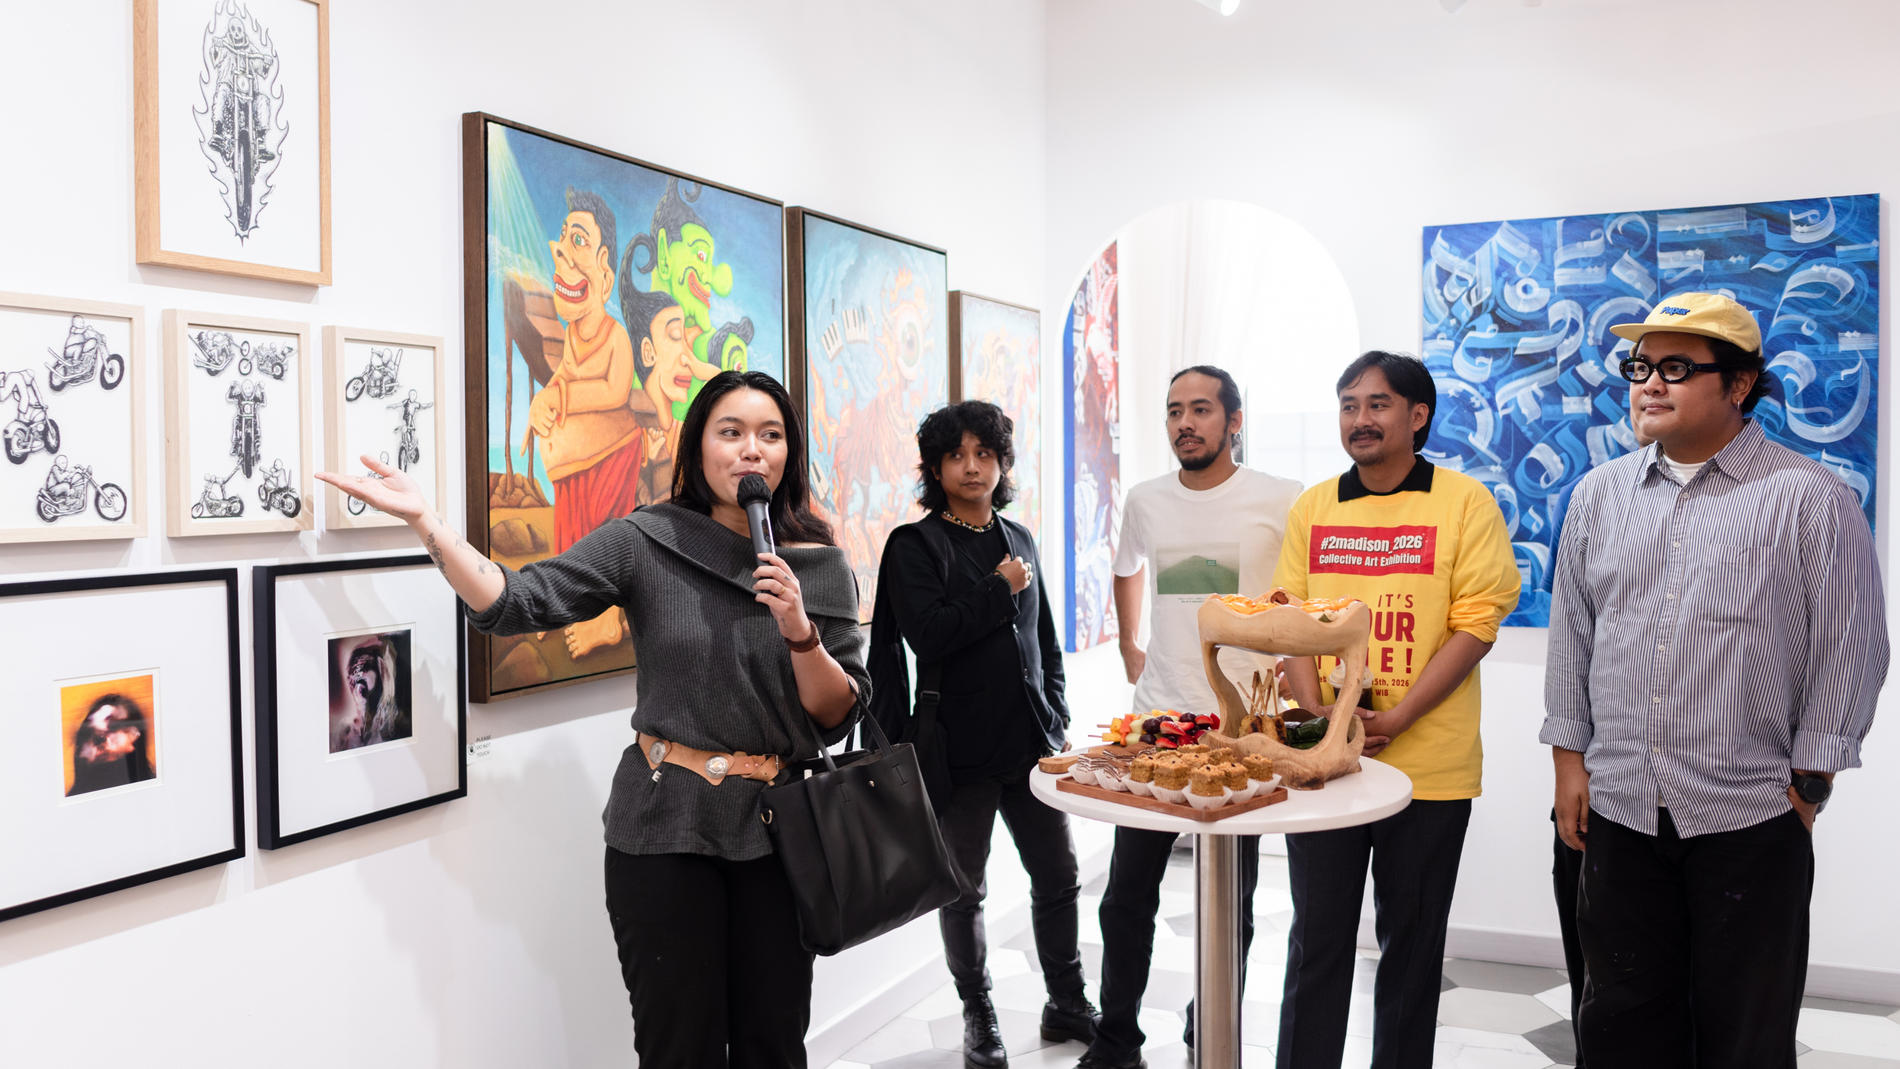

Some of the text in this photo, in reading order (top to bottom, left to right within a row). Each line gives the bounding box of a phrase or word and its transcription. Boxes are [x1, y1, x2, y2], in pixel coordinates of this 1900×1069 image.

[1321, 535, 1423, 554] #2madison_2026
[1319, 554, 1363, 565] Collective
[1365, 556, 1379, 567] Art
[1369, 608, 1415, 643] UR
[1391, 678, 1410, 687] 2026
[1375, 689, 1389, 697] WIB
[476, 734, 491, 742] PLEASE
